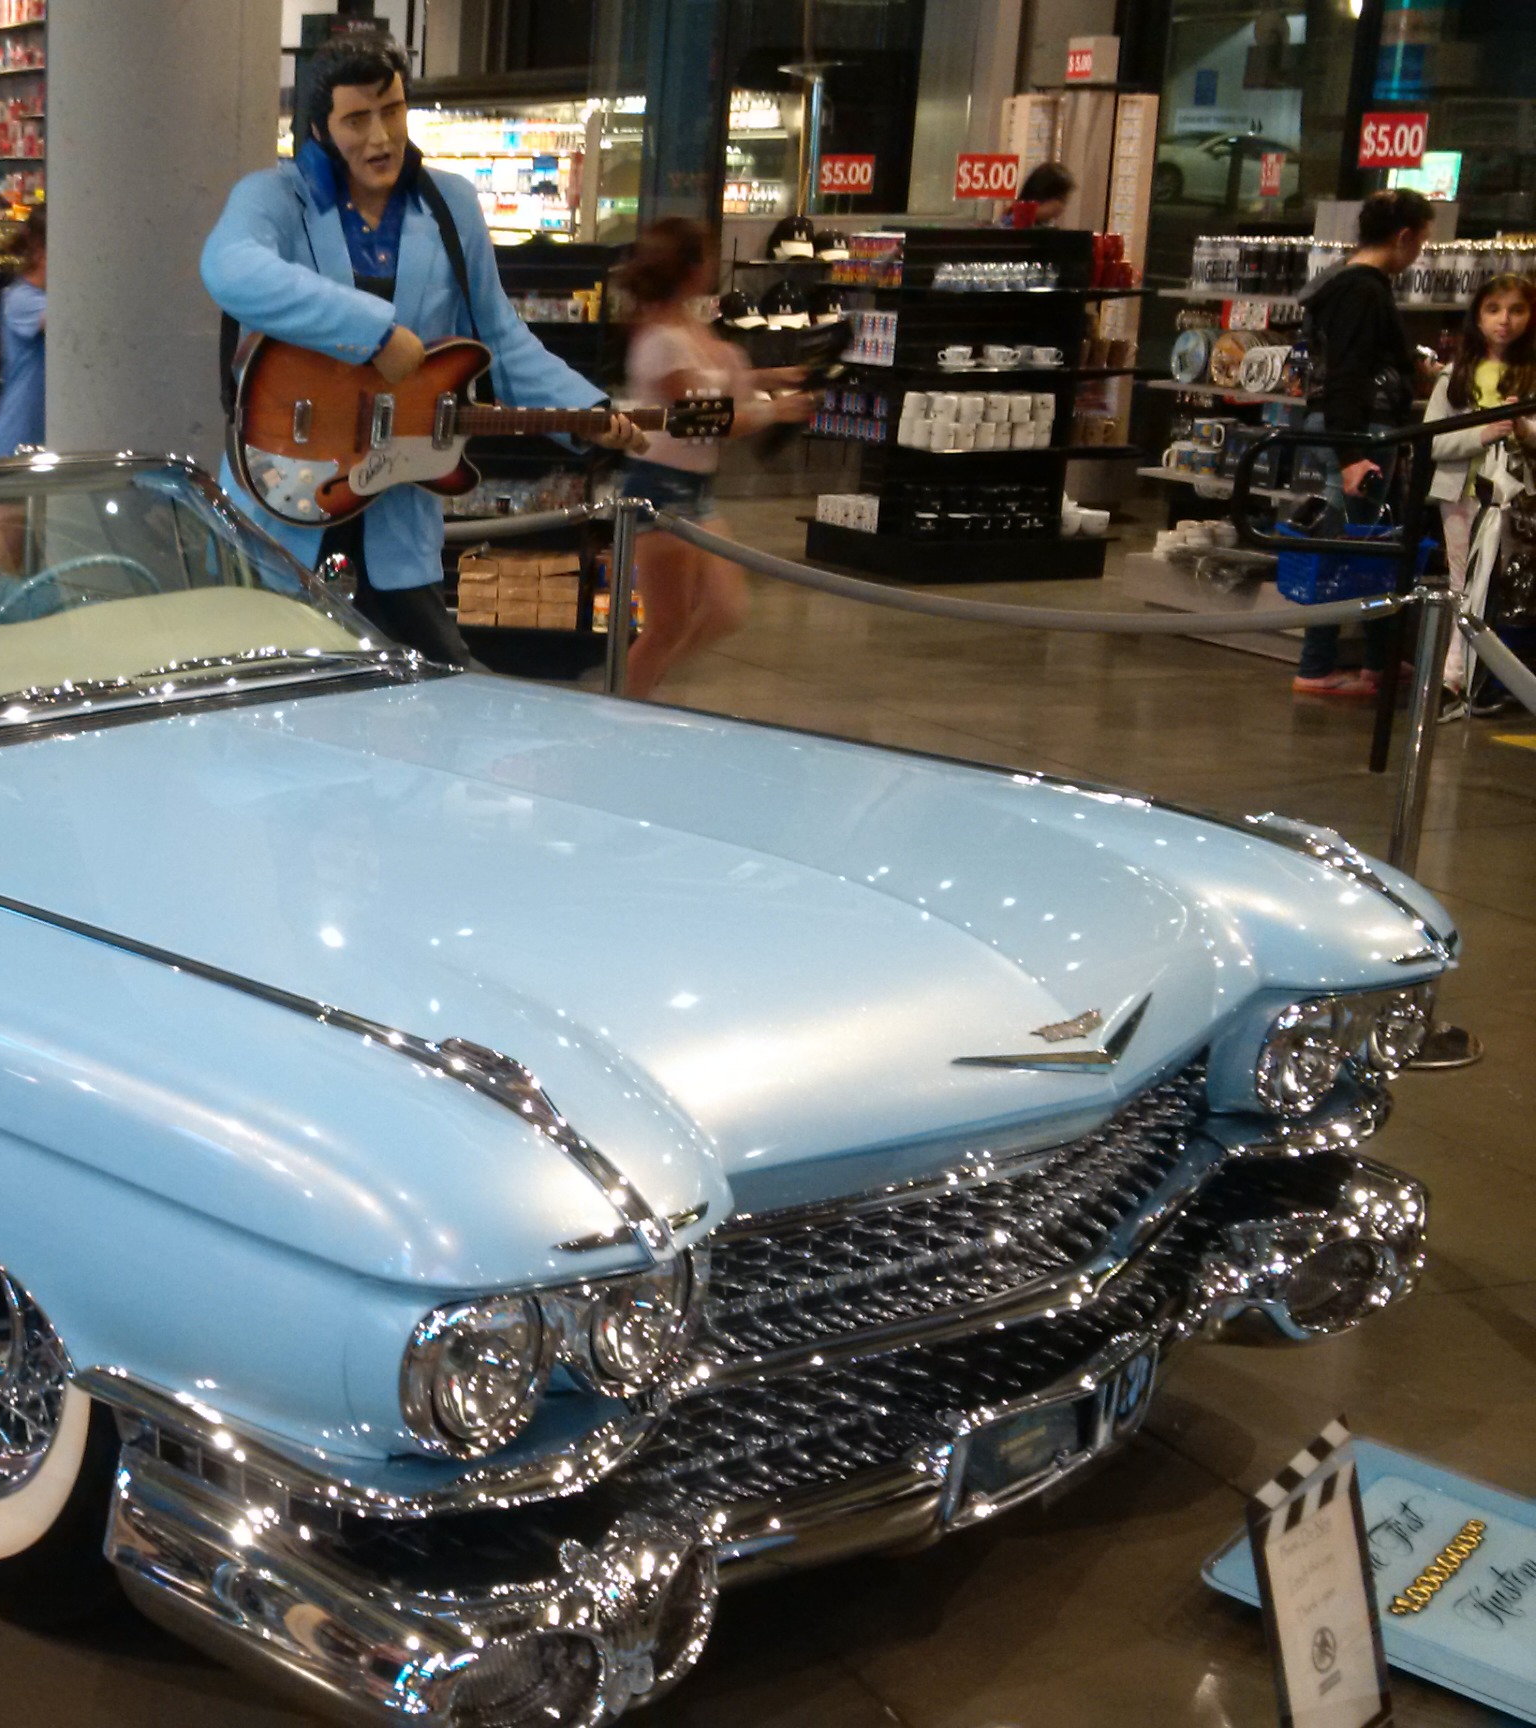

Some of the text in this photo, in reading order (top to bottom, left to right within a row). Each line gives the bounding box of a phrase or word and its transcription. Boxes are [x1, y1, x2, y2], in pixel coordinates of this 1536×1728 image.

[1364, 122, 1423, 158] $5.00
[821, 160, 872, 186] $5.00
[958, 160, 1018, 191] $5.00
